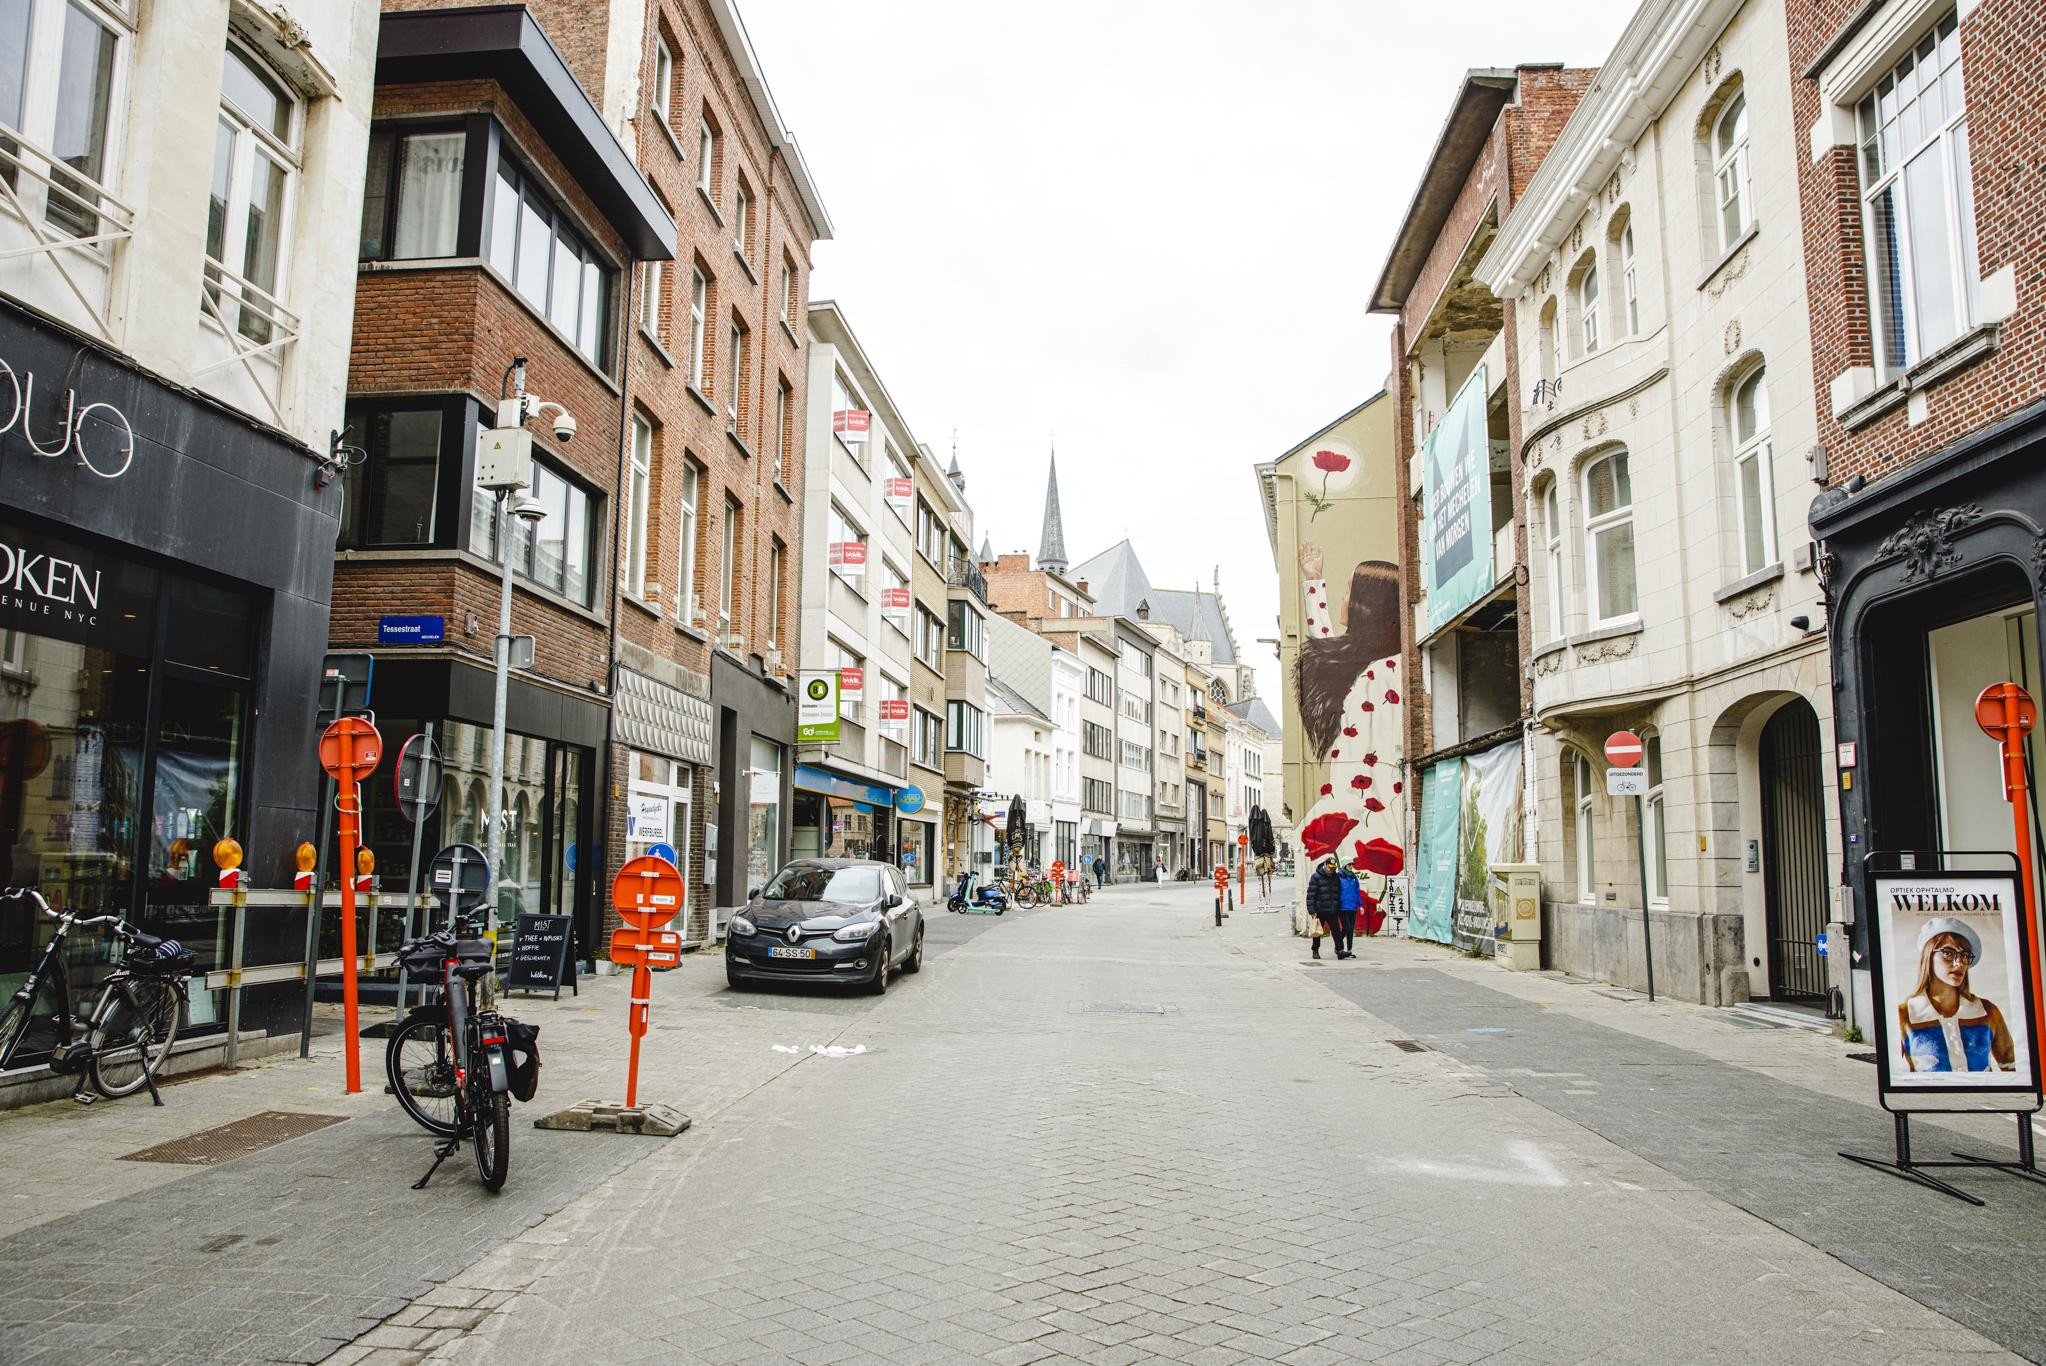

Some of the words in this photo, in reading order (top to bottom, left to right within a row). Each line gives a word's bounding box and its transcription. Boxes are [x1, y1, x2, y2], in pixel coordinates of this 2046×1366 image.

[1447, 472, 1480, 521] MECHELEN
[1445, 510, 1468, 550] MORGEN
[64, 609, 97, 626] NYC
[480, 808, 518, 834] MST
[1892, 894, 2000, 912] WELKOM
